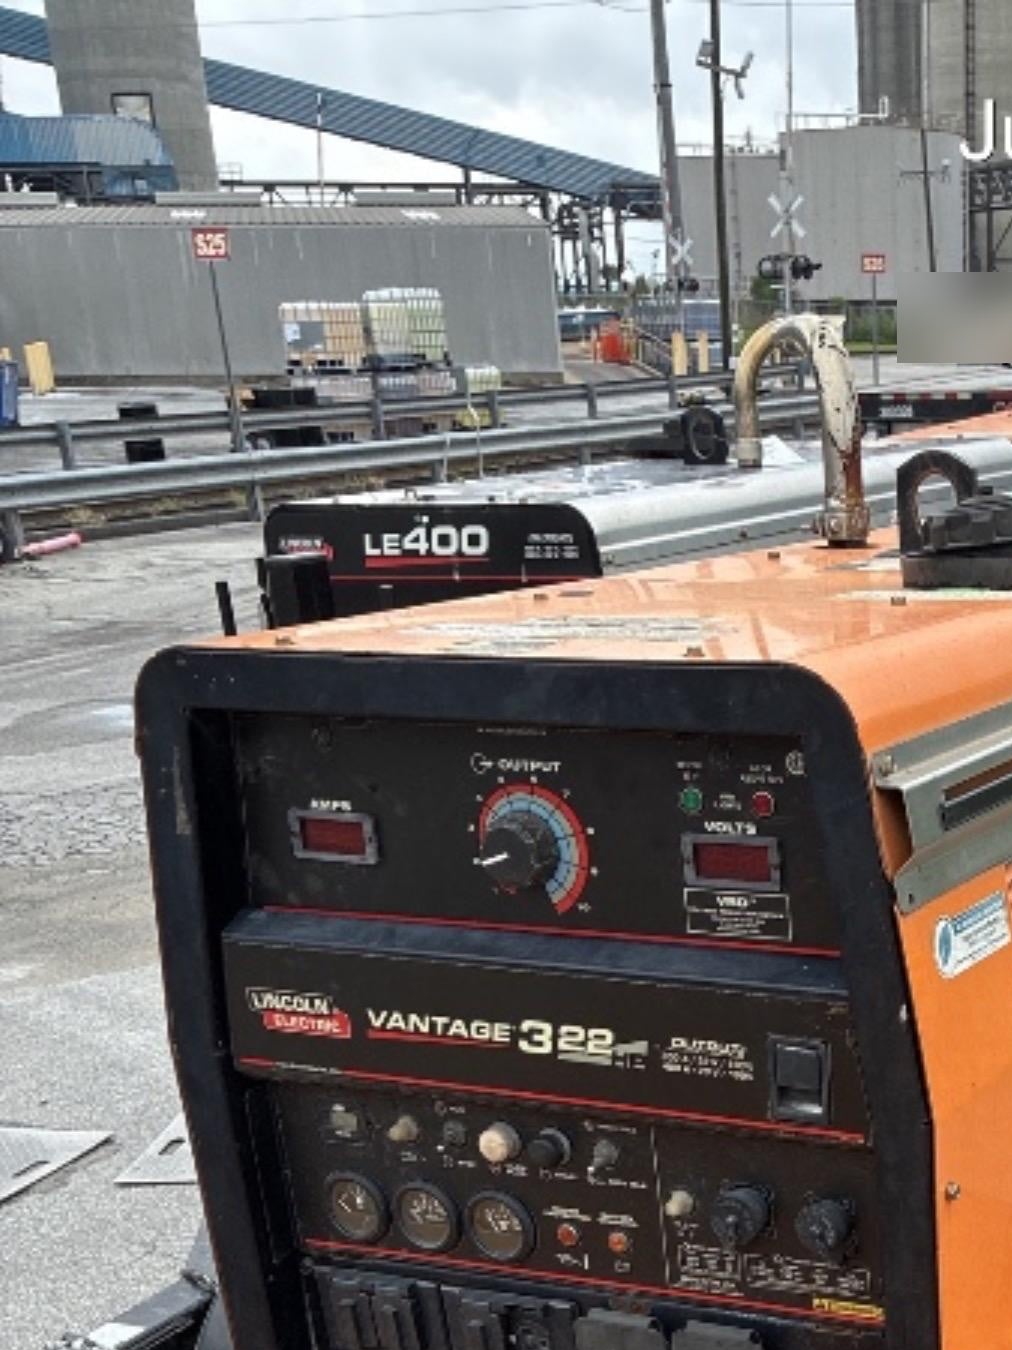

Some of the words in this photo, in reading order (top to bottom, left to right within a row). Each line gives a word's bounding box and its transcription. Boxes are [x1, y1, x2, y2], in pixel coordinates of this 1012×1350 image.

[364, 524, 489, 556] LE400
[250, 991, 330, 1015] LINCOLN
[366, 1008, 512, 1043] VANTAGE
[518, 1019, 614, 1056] 322
